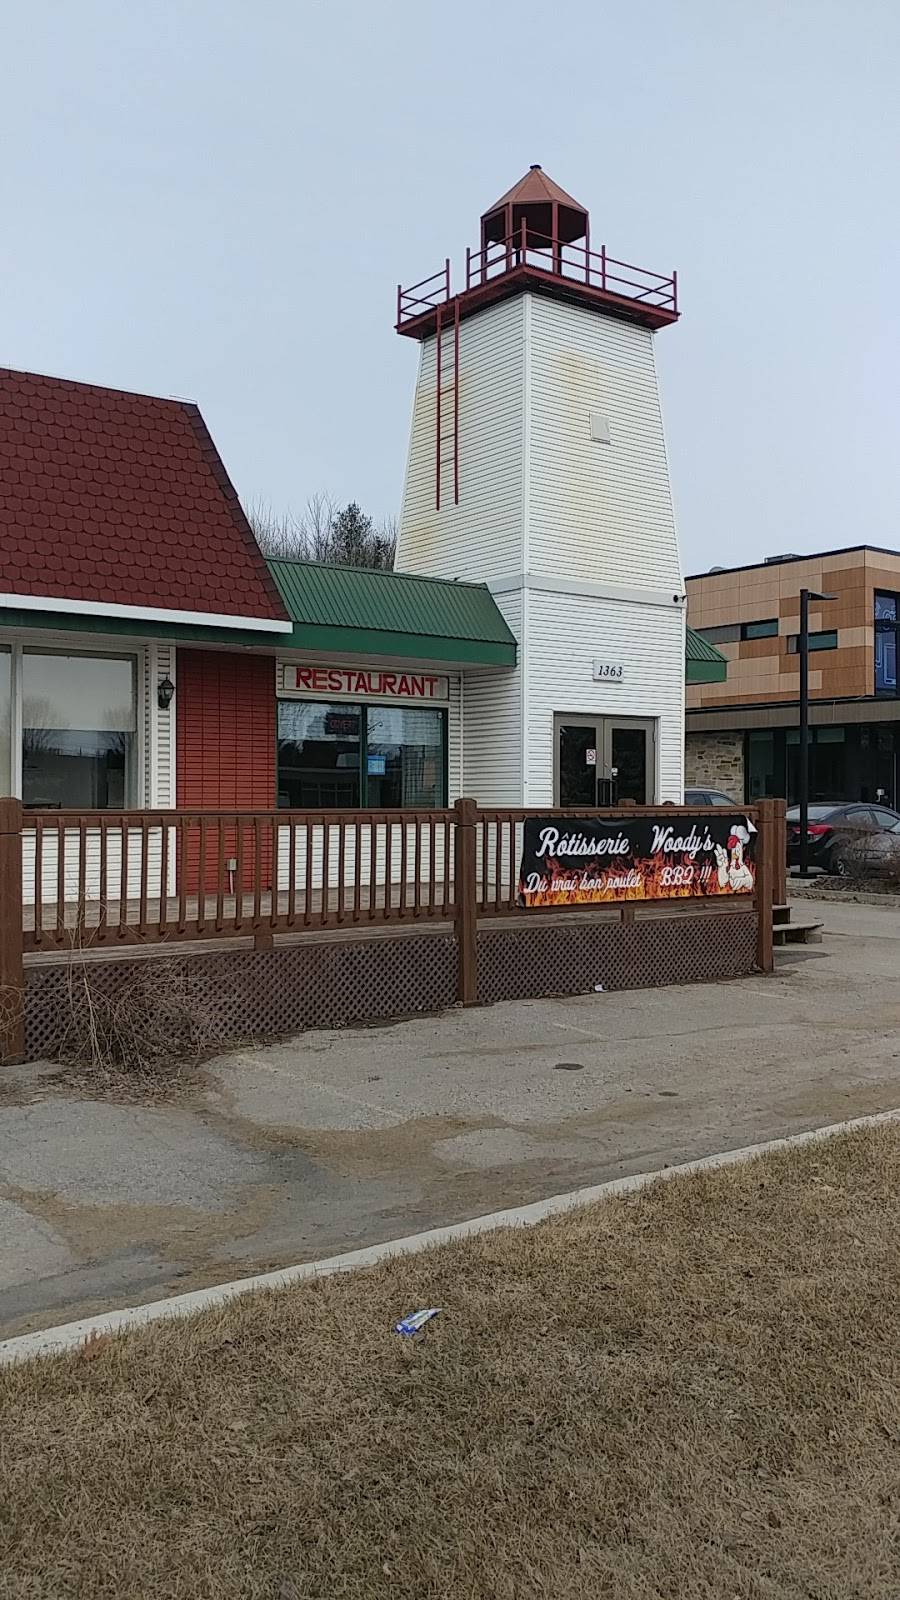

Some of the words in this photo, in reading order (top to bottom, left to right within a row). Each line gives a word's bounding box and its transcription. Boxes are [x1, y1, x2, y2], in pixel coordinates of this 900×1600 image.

[296, 667, 438, 696] RESTAURANT
[598, 665, 623, 677] 1363
[536, 826, 629, 857] Rôtisserie
[651, 825, 715, 859] Woody's
[524, 872, 547, 893] Du
[551, 876, 577, 891] vrai
[579, 874, 603, 889] bon
[603, 869, 641, 893] poulet
[659, 865, 694, 886] BBQ
